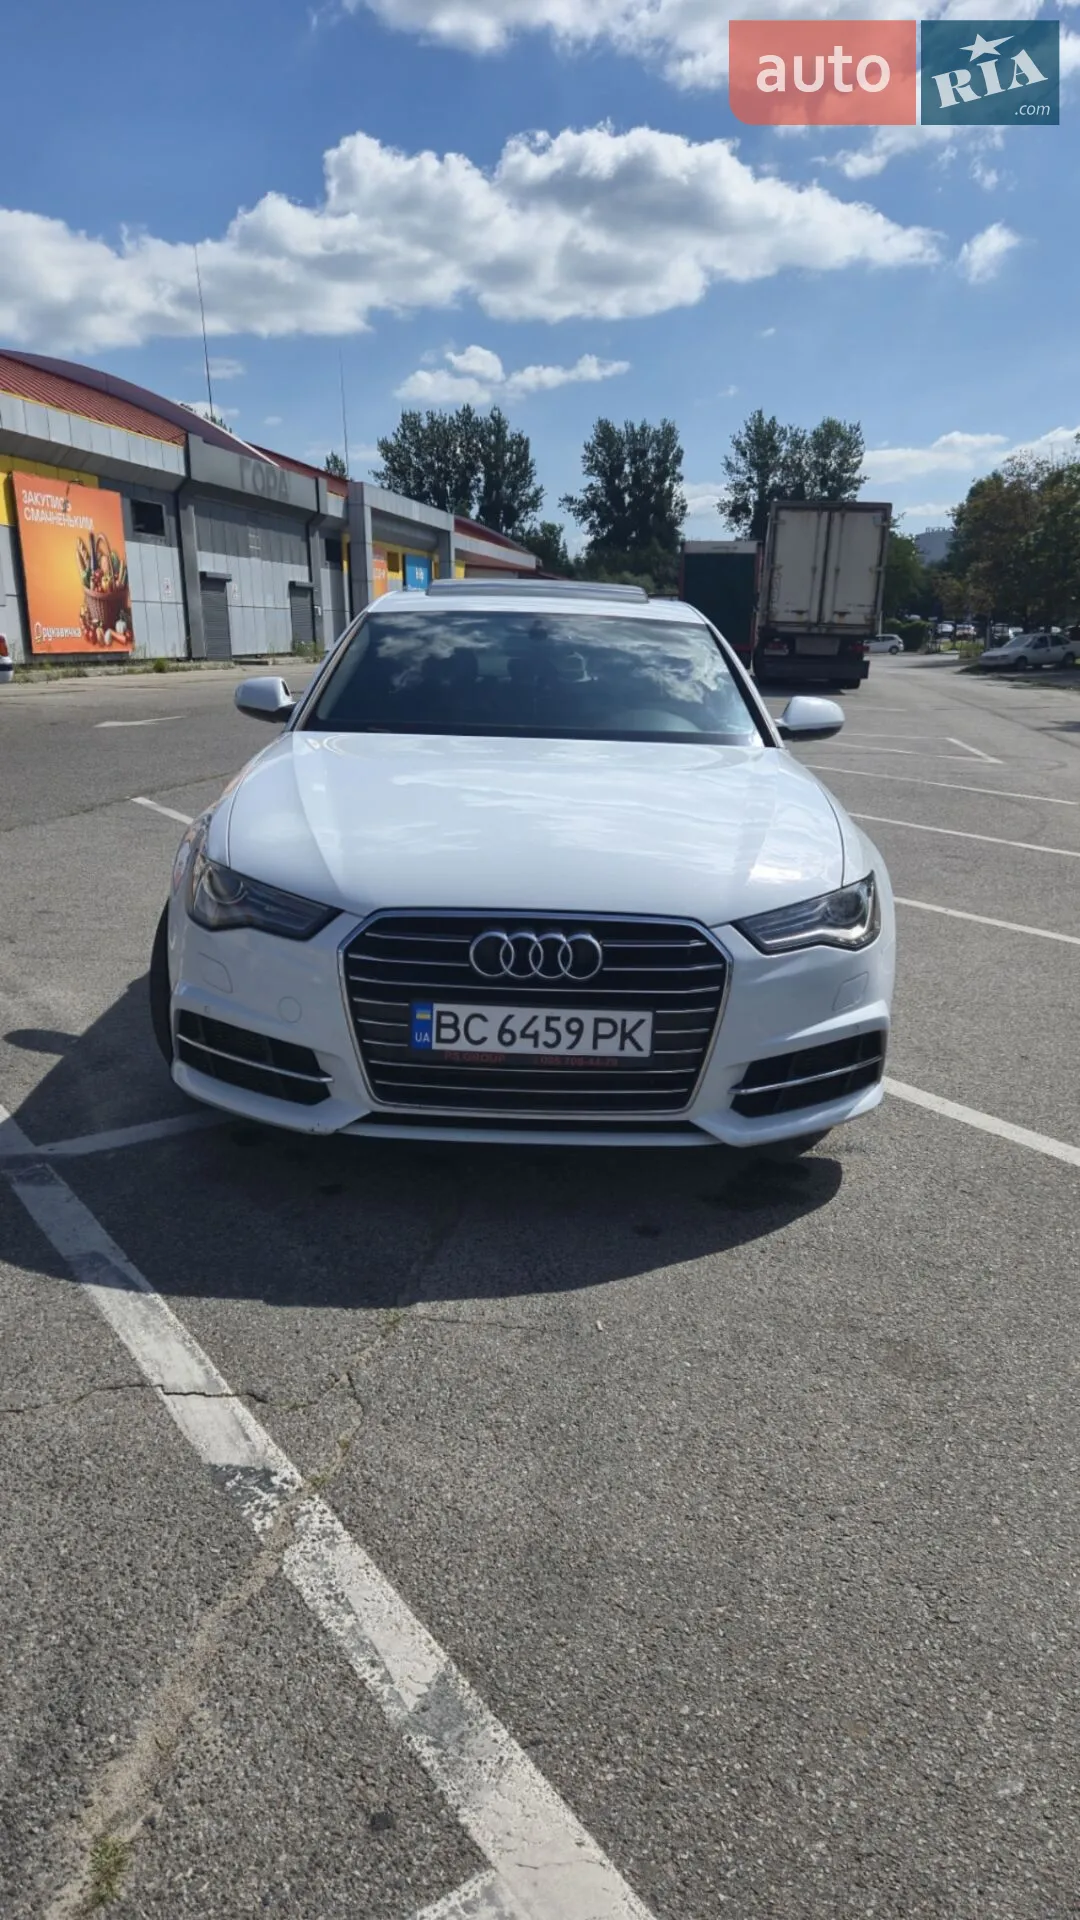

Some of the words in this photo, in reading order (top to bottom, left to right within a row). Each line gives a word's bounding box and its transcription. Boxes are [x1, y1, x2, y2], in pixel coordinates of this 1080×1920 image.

[24, 507, 95, 531] СМАЧНЕНЬКИМ
[415, 1032, 431, 1043] UA
[435, 1010, 489, 1046] BC
[497, 1014, 585, 1050] 6459
[592, 1017, 647, 1052] PK
